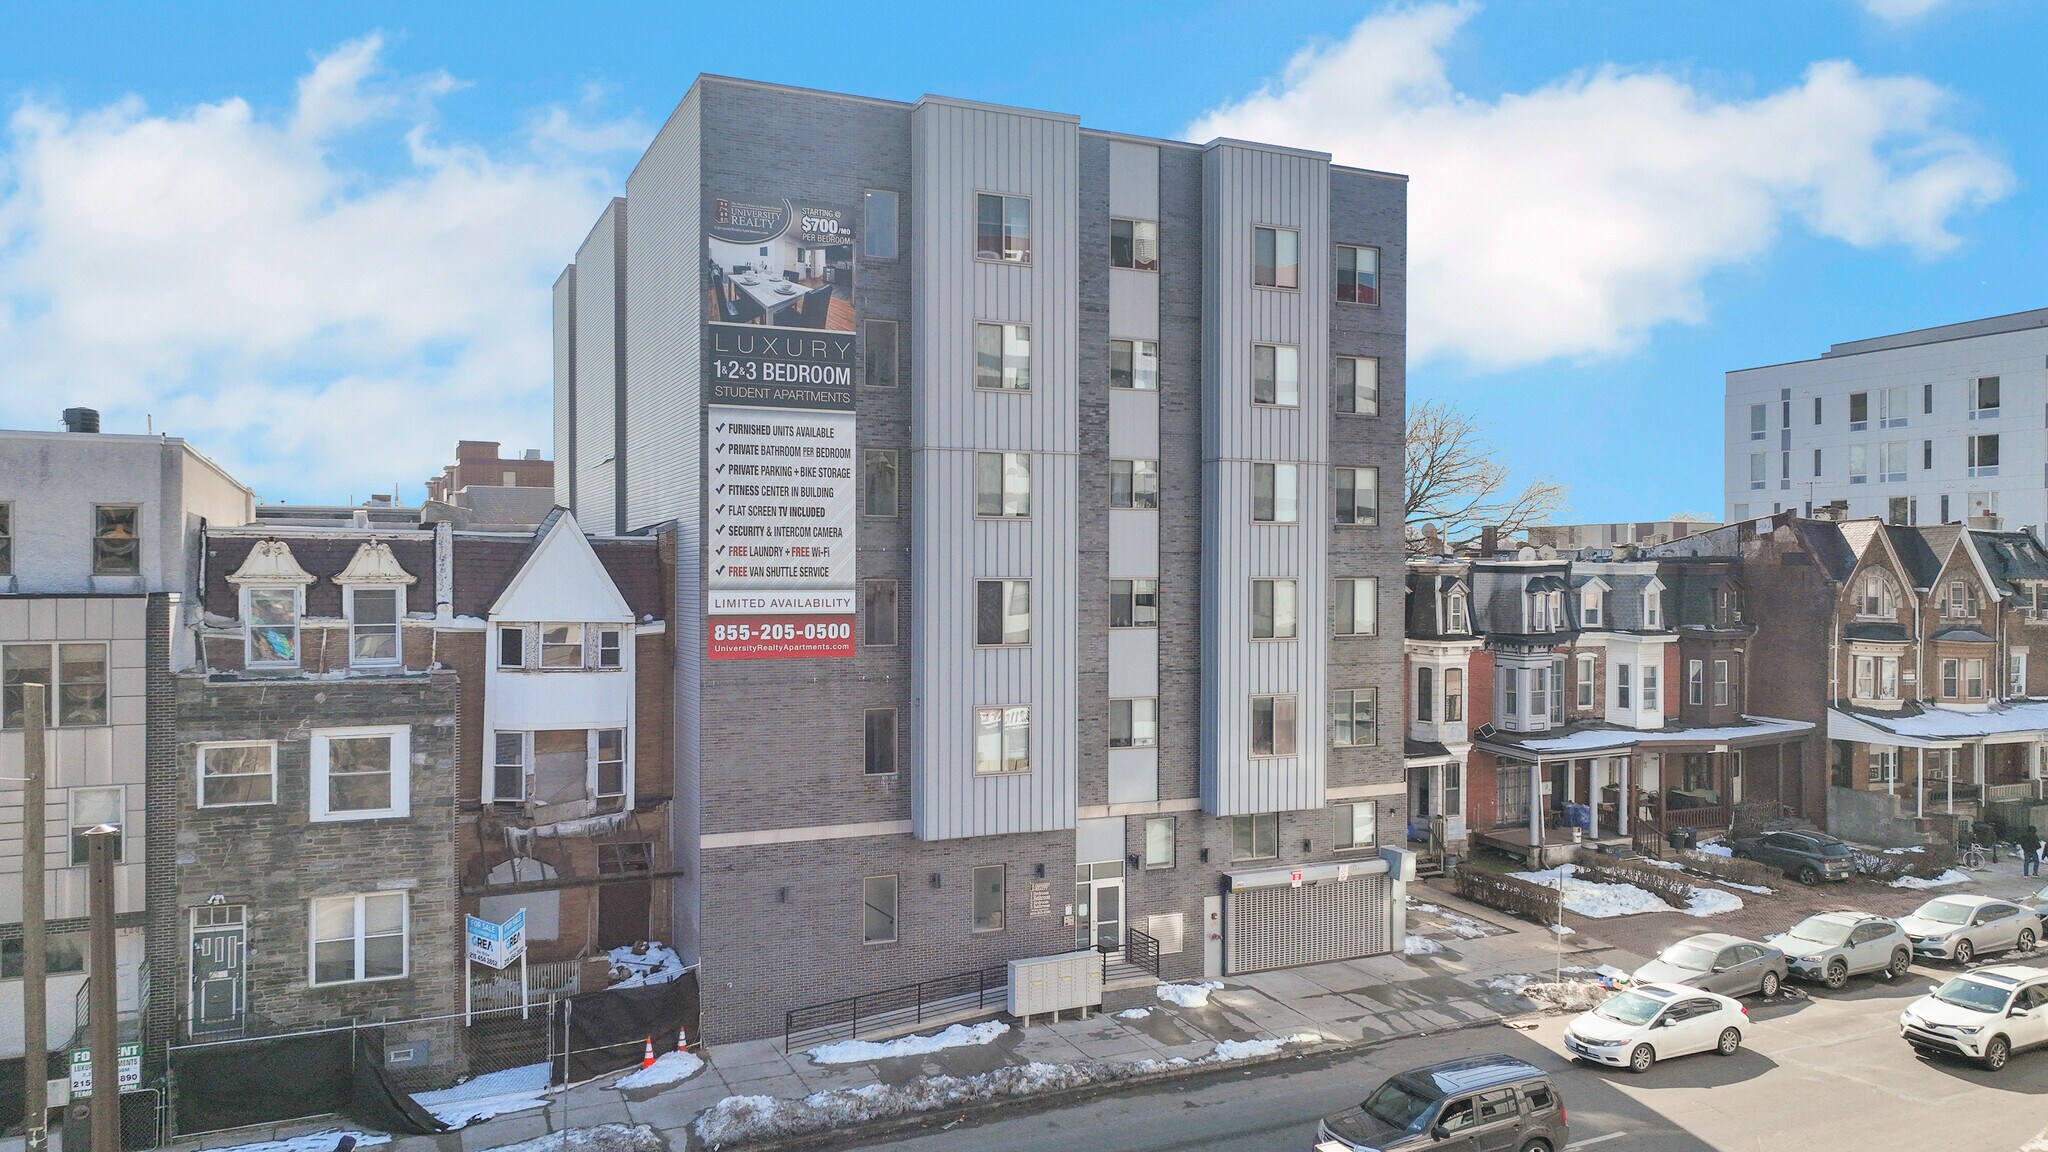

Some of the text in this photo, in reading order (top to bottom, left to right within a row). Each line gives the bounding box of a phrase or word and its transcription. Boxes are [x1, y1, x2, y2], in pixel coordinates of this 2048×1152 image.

[731, 208, 781, 220] UNIVERSITY
[802, 207, 842, 218] STARTING @
[731, 216, 774, 229] REALTY
[802, 215, 838, 234] $700
[802, 233, 850, 244] PER BEDROOM
[715, 333, 850, 360] LUXURY
[714, 360, 850, 386] 1&2&3 BEDROOM
[715, 386, 850, 403] STUDENT APARTMENTS
[728, 424, 834, 438] FURNISHED UNITS AVAILABLE
[728, 444, 851, 458] PRIVATE BATHROOM PER BEDROOM
[728, 464, 759, 475] PRIVATE
[761, 465, 792, 476] PARKING
[800, 466, 816, 477] BIKE
[818, 467, 851, 478] STORAGE
[728, 484, 834, 498] FITNESS CENTER IN BUILDING
[728, 505, 825, 517] FLAT SCREEN TV INCLUDED
[728, 526, 843, 537] SECURITY & INTERCOM CAMERA
[728, 546, 747, 556] FREE
[749, 546, 783, 557] LAUNDRY
[792, 547, 810, 557] FREE
[812, 547, 830, 557] Wi-Fi
[728, 566, 829, 577] FREE VAN SHUTTLE SERVICE
[715, 598, 850, 608] LIMITED AVAILABILITY
[714, 623, 850, 641] 855-205-0500
[714, 644, 849, 652] UniversityRealtyApartments.com
[482, 923, 495, 933] SALE
[74, 1051, 91, 1062] FO
